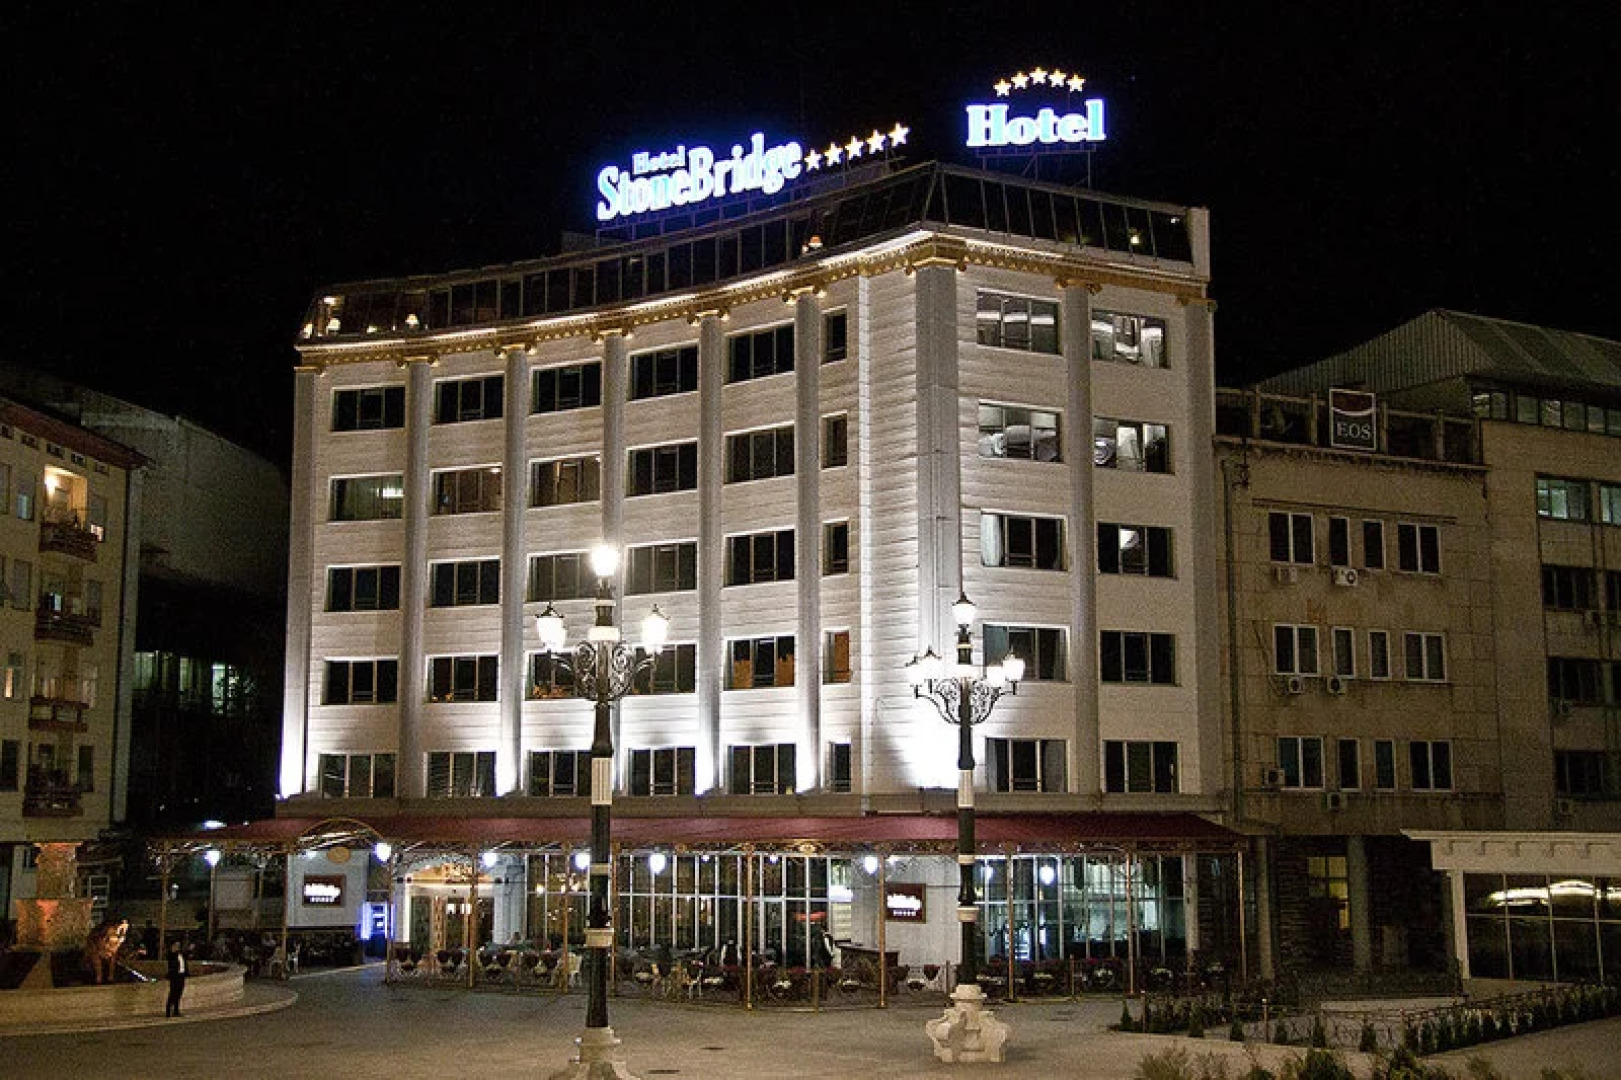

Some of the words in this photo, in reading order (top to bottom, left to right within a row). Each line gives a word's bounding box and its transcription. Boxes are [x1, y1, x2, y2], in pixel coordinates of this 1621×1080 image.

[966, 99, 1106, 148] Hotel
[632, 145, 687, 175] Hotel
[1336, 421, 1371, 439] EOS
